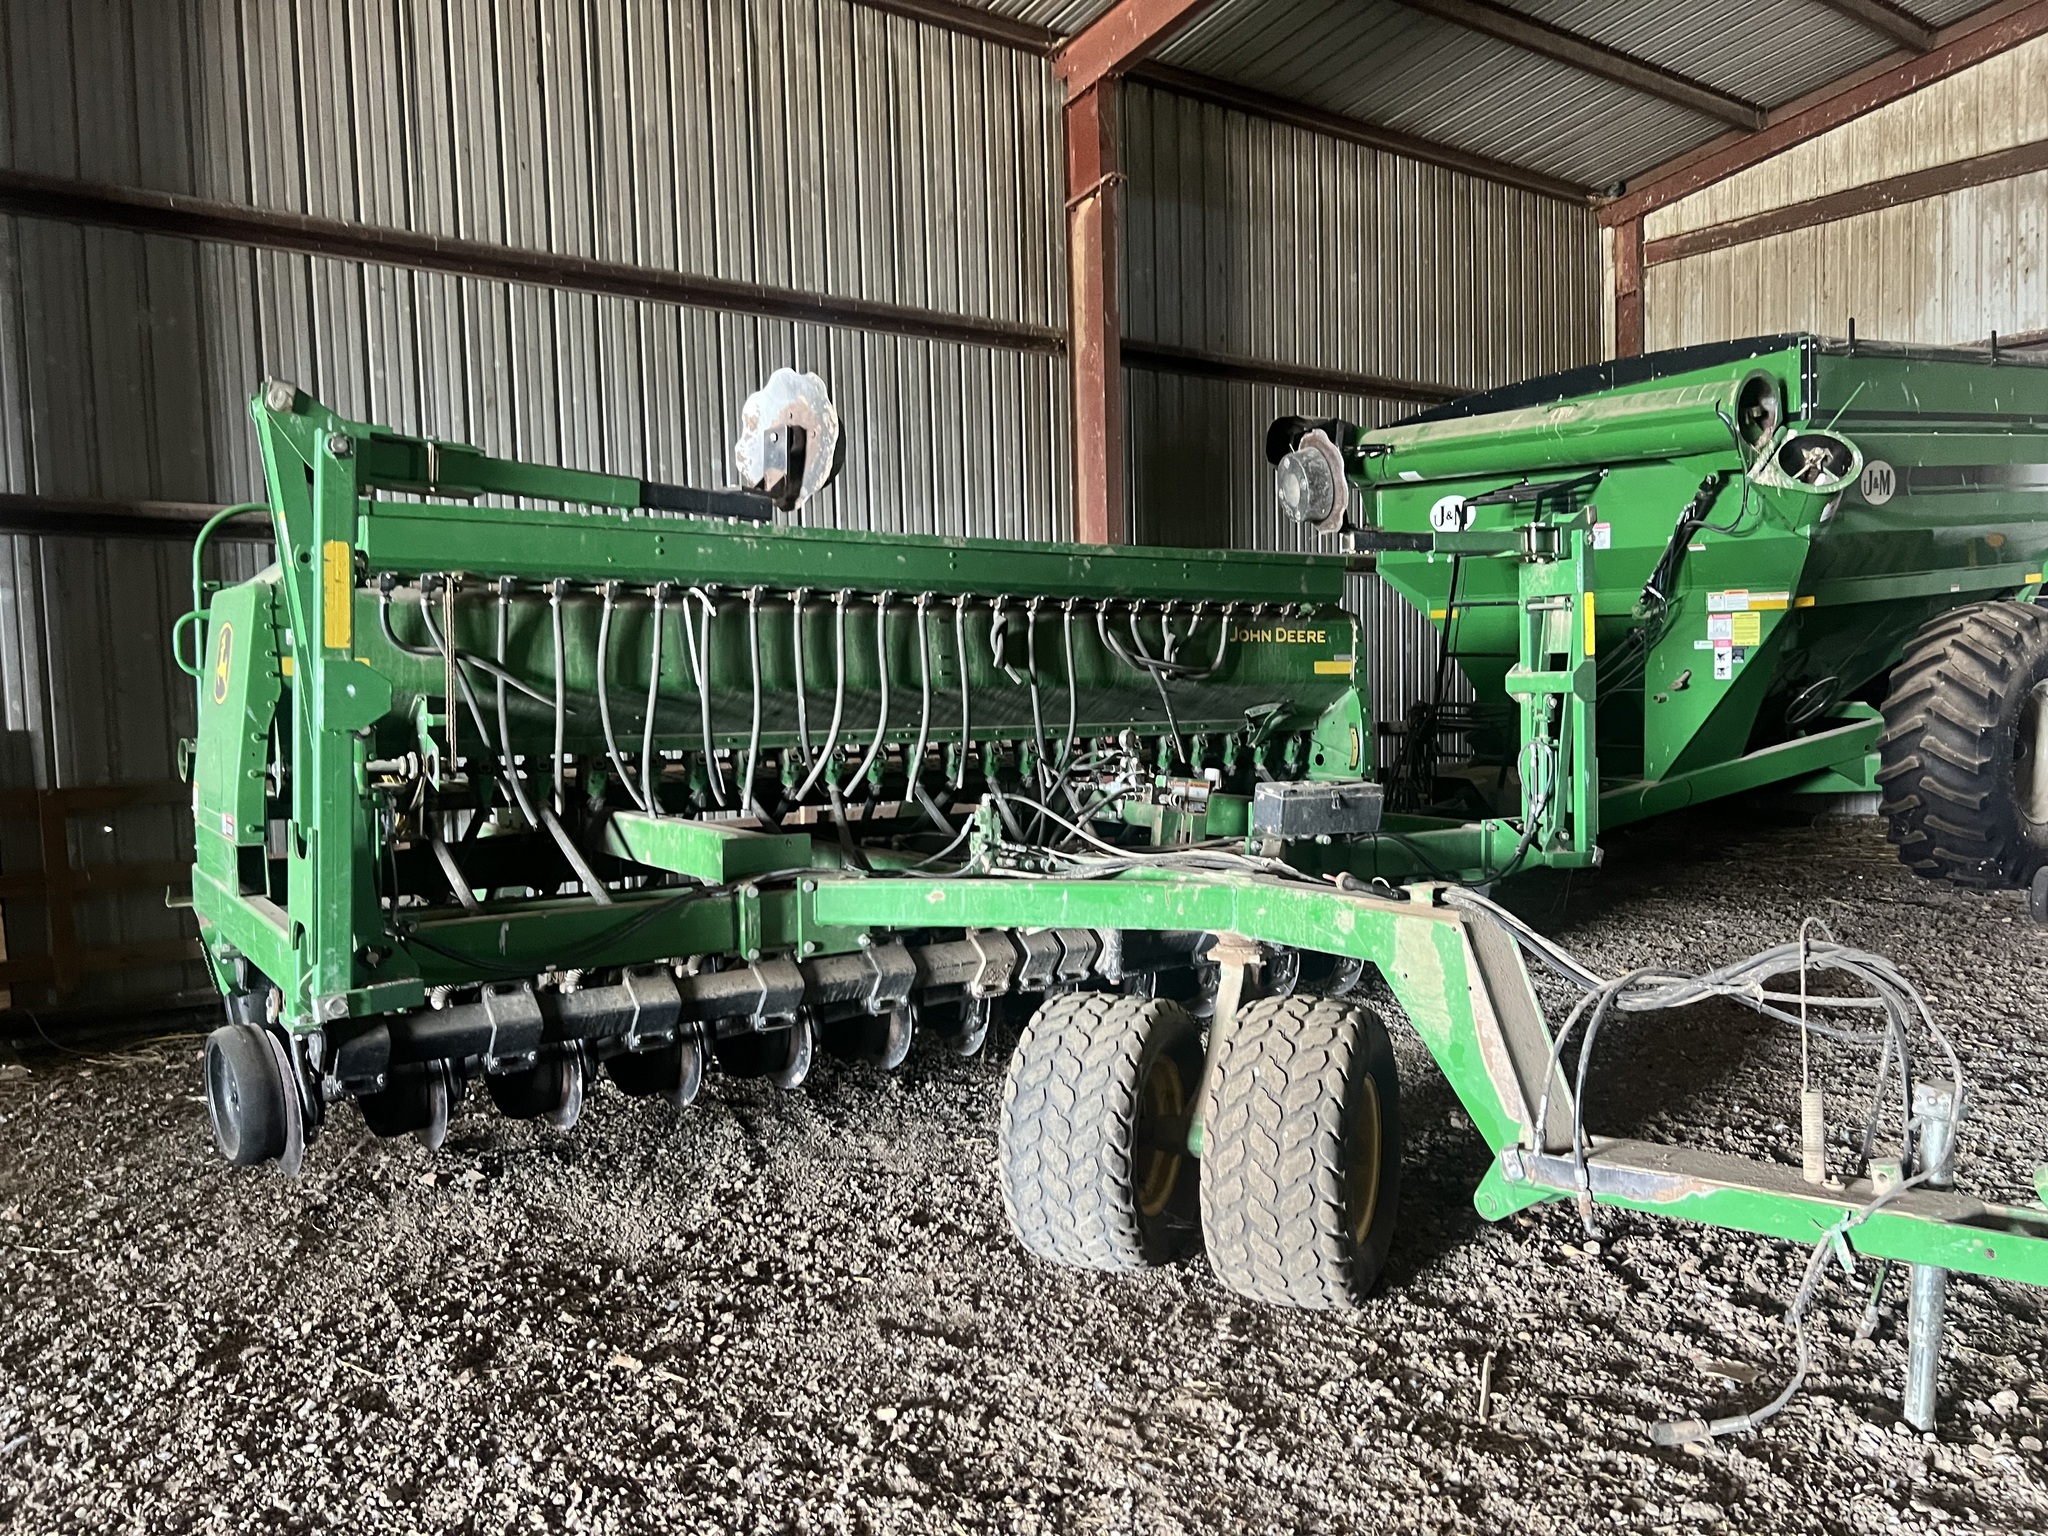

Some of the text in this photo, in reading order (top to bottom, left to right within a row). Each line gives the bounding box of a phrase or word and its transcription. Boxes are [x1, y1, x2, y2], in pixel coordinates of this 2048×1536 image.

[1863, 469, 1891, 496] J&M
[1229, 626, 1326, 643] JOHN DEERE
